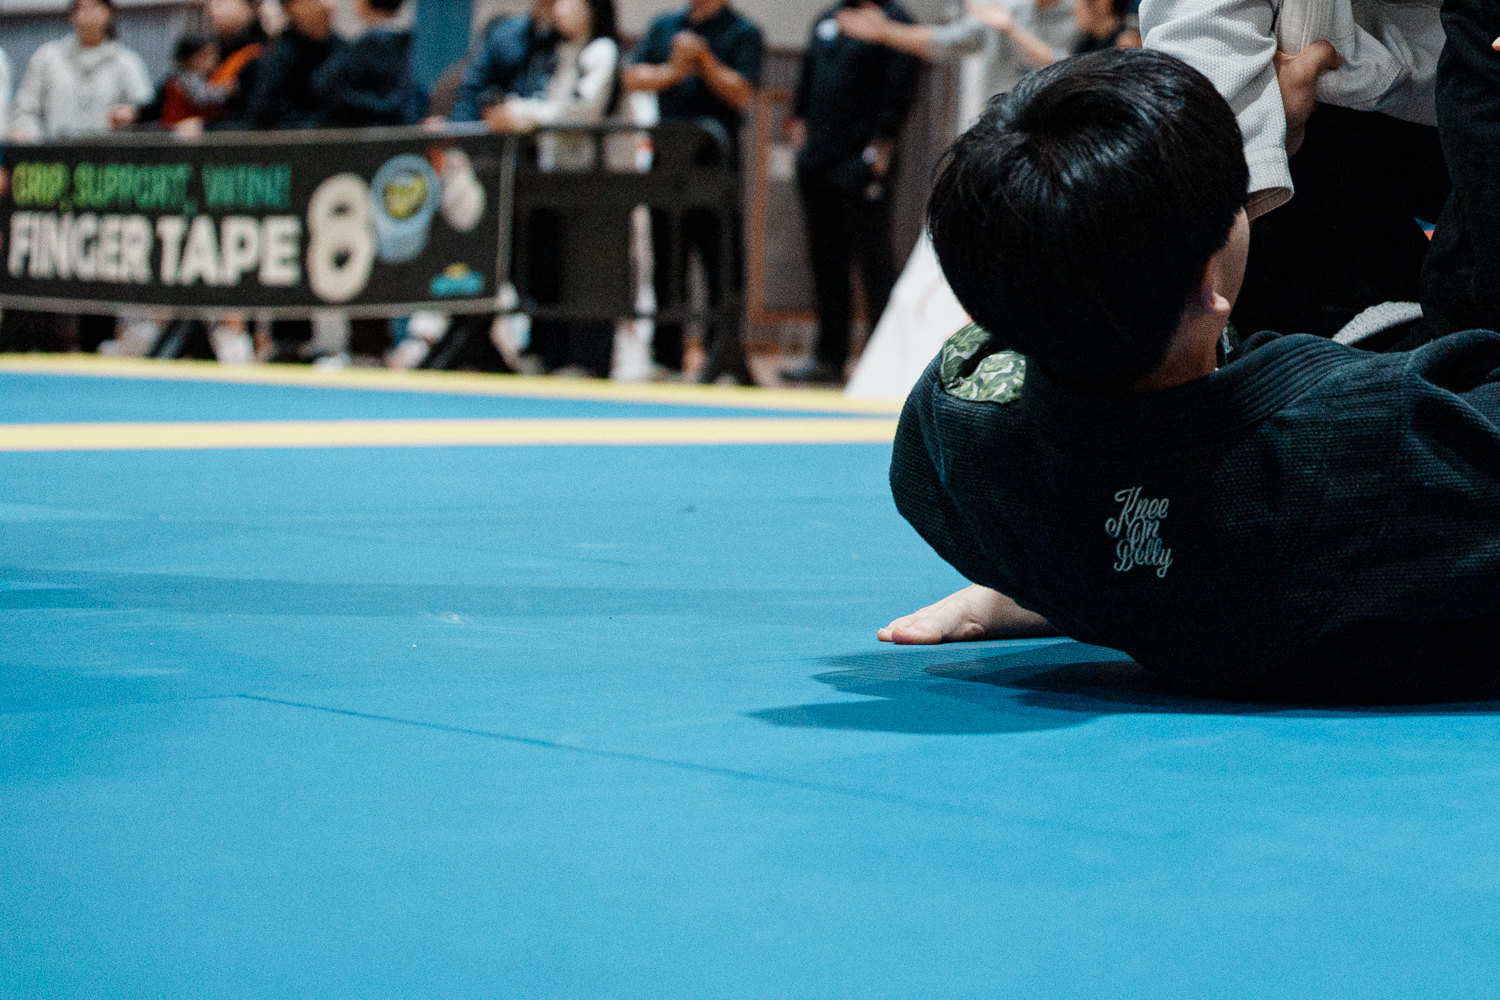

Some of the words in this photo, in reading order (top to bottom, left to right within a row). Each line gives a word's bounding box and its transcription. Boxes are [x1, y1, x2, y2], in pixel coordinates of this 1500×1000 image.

[8, 211, 153, 284] FINGER
[156, 214, 302, 287] TAPE
[1105, 485, 1169, 538] Knee
[1126, 517, 1161, 550] On
[1113, 538, 1173, 578] Belly
